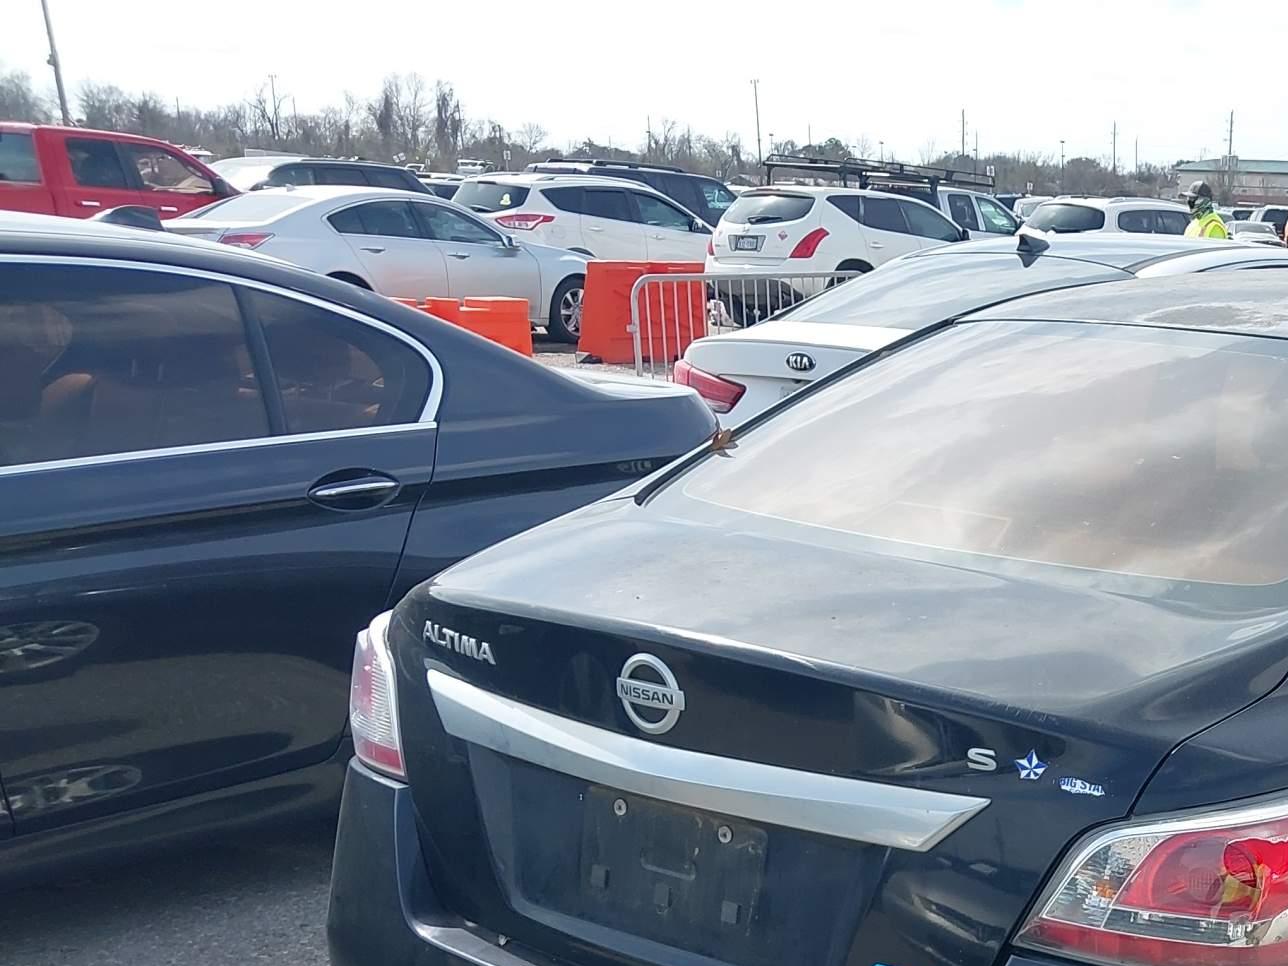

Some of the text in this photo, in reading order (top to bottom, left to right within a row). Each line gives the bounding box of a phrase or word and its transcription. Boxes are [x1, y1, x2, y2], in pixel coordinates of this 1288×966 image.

[789, 355, 810, 369] KIA
[422, 619, 497, 665] ALTIMA
[620, 683, 674, 705] NISSAN
[967, 747, 997, 772] S
